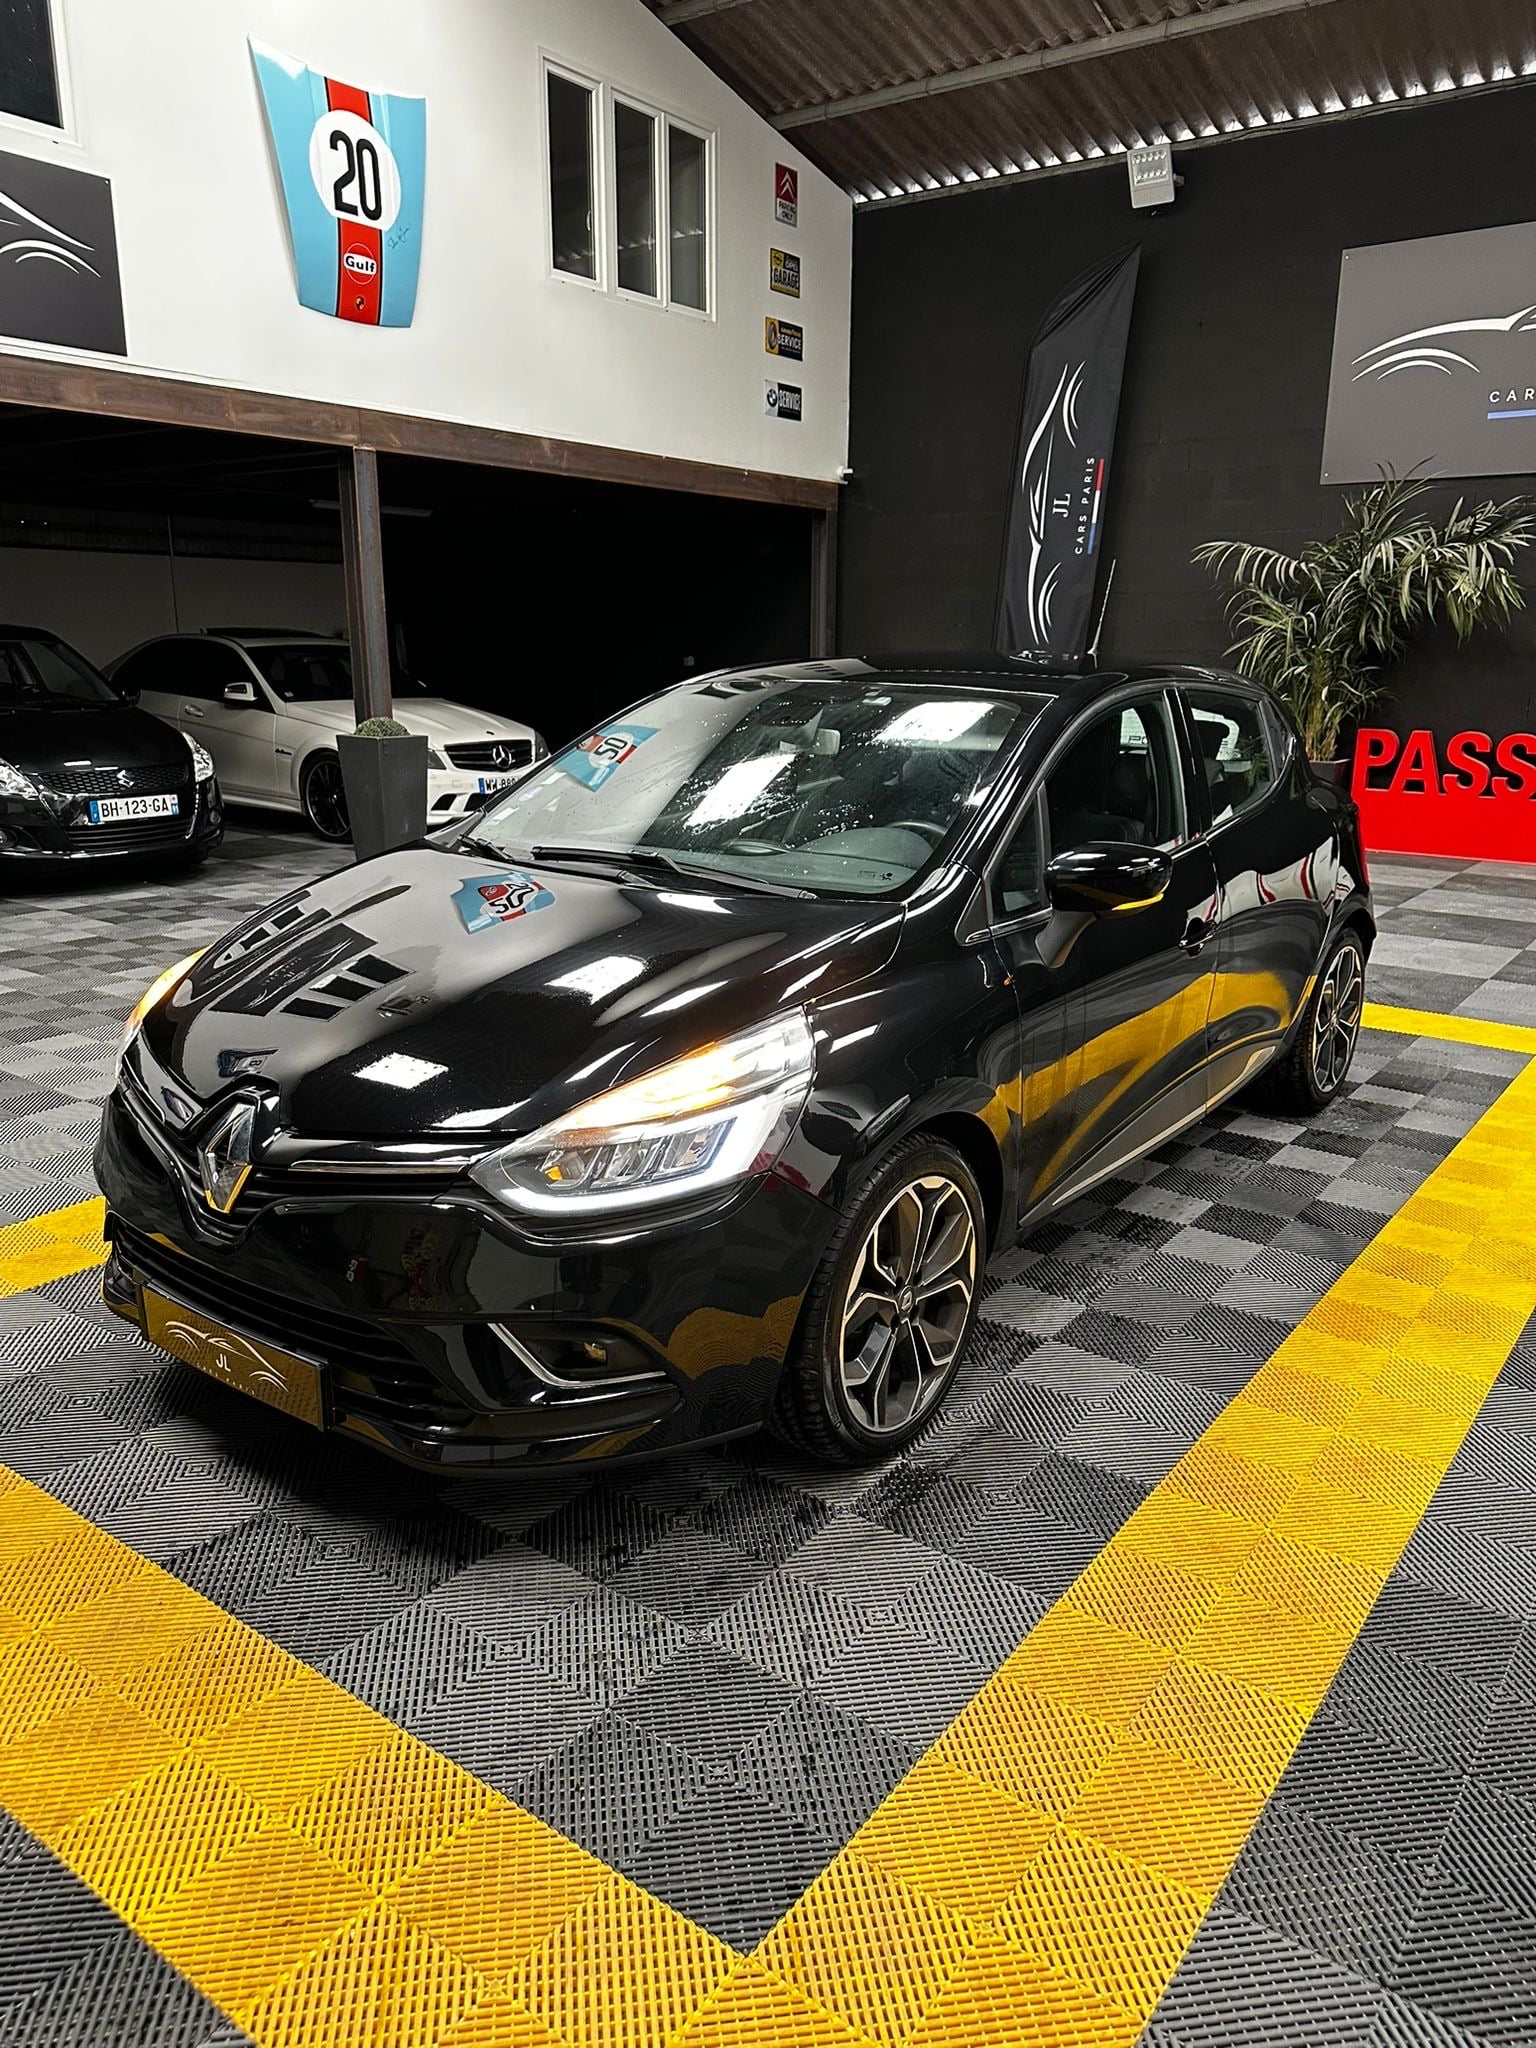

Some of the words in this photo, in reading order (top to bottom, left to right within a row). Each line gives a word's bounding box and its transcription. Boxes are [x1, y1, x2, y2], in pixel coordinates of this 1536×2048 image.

[329, 130, 382, 221] 20
[345, 255, 376, 273] Gulf
[773, 267, 799, 290] GARAGE
[776, 333, 802, 350] SERVICE
[778, 389, 801, 411] SERVICE
[1052, 493, 1071, 518] JL
[1075, 515, 1087, 554] CARS
[1081, 457, 1095, 504] PARIS
[101, 797, 169, 818] BH-123-GA
[216, 1353, 232, 1372] JL
